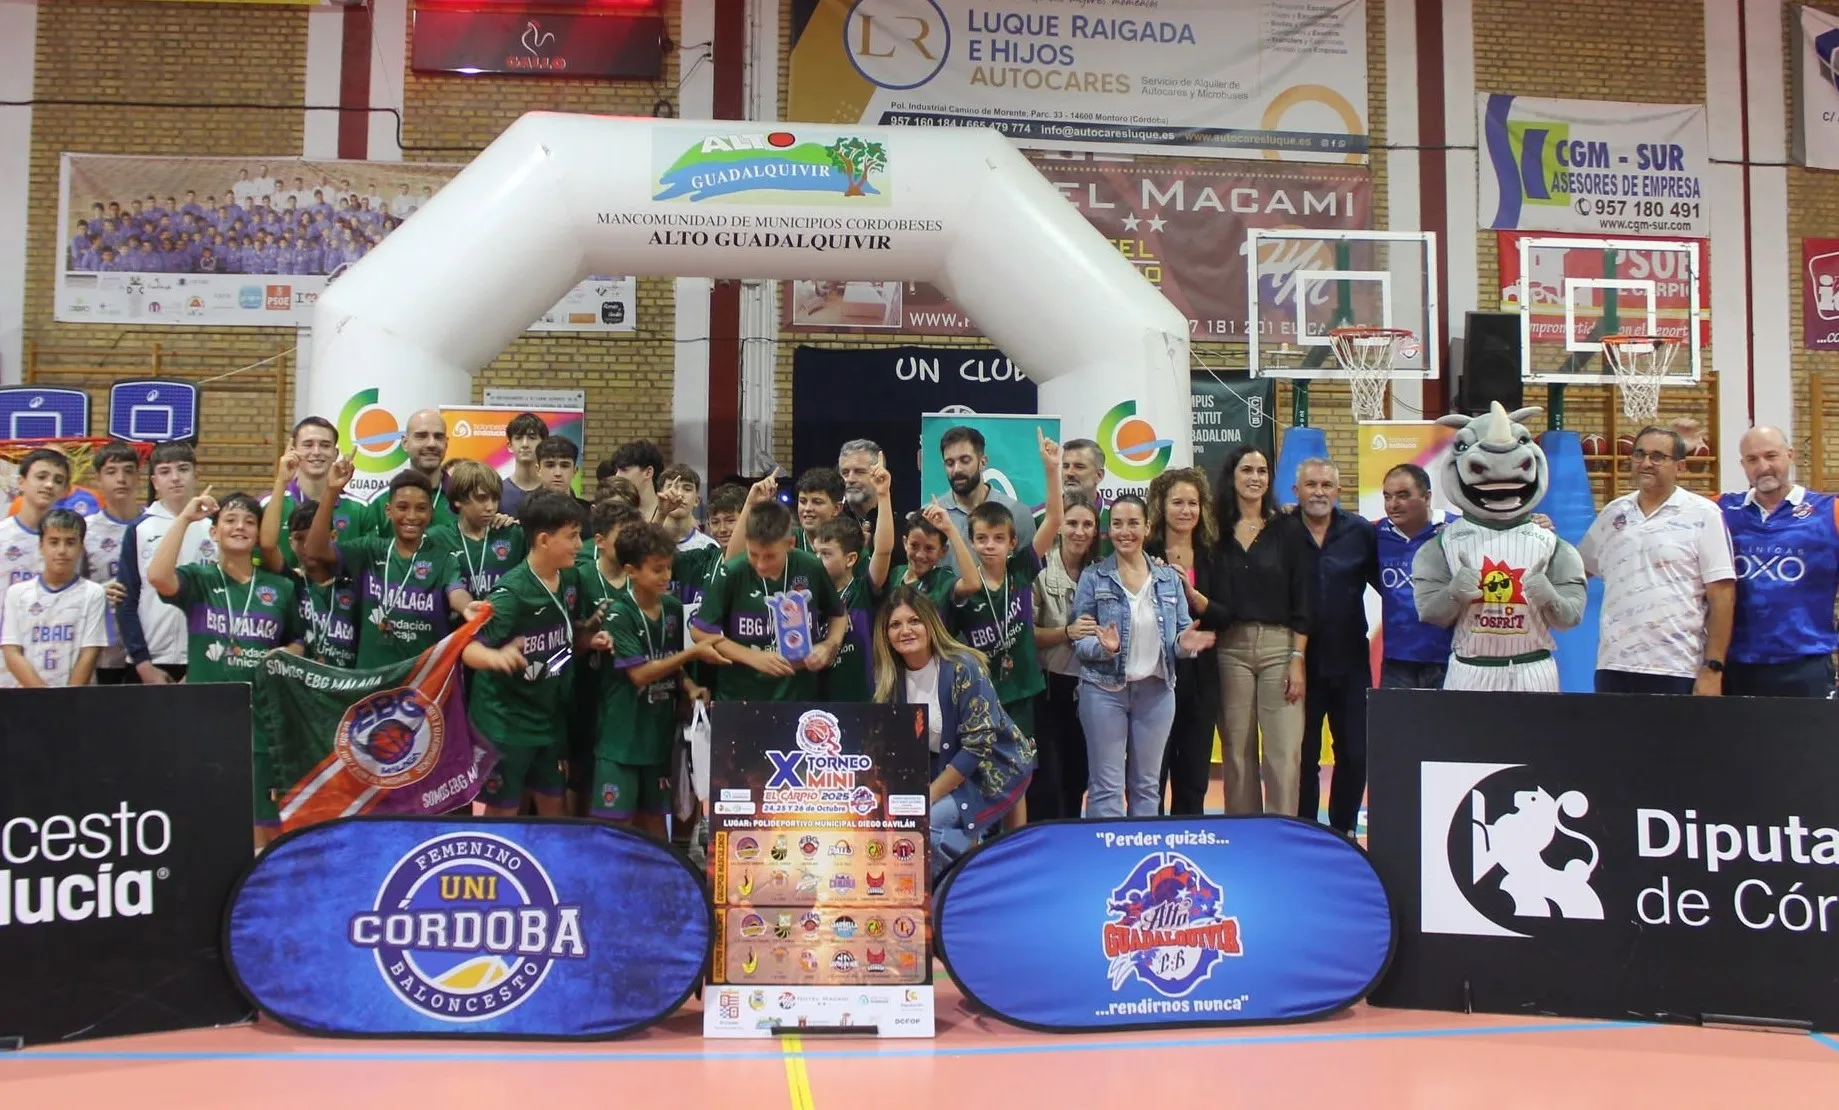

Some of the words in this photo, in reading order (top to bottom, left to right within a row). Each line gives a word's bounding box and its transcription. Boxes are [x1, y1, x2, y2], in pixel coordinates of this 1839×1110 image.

[968, 9, 1059, 37] LUQUE
[1072, 14, 1196, 45] RAIGADA
[969, 40, 982, 61] E
[991, 40, 1075, 66] HIJOS
[970, 66, 1131, 94] AUTOCARES
[1141, 76, 1178, 87] Servicio
[1181, 78, 1191, 87] de
[1194, 79, 1227, 90] Alquiler
[1229, 81, 1240, 89] de
[1141, 86, 1188, 97] Autocares
[1189, 90, 1195, 98] y
[1197, 89, 1249, 100] Microbuses
[891, 101, 906, 110] Pol.
[909, 102, 947, 112] Industrial
[949, 105, 980, 114] Camino
[981, 106, 992, 115] de
[994, 108, 1029, 118] Morente,
[1031, 109, 1050, 118] Parc.
[1053, 110, 1063, 118] 33
[1070, 112, 1093, 121] 14600
[1096, 112, 1128, 122] Montoro
[1130, 114, 1169, 125] (Córdoba)
[890, 116, 909, 126] 957
[914, 117, 934, 127] 160
[1012, 123, 1031, 133] 774
[1041, 124, 1175, 142] info@autocaresluque.es
[1184, 130, 1311, 147] www.autocaresluque.es
[1556, 140, 1610, 168] CGM
[1637, 144, 1685, 171] SUR
[691, 164, 831, 190] GUADALQUIVIR
[1551, 171, 1618, 196] ASESORES
[1623, 175, 1638, 197] DE
[1643, 175, 1700, 199] EMPRESA
[1142, 178, 1354, 217] MACAMI
[1595, 200, 1626, 217] 957
[1633, 201, 1664, 218] 180
[1670, 202, 1700, 219] 491
[597, 212, 727, 228] MANCOMUNIDAD
[731, 216, 751, 228] DE
[755, 217, 842, 231] MUNICIPIOS
[846, 218, 943, 232] CORDOBESES
[1600, 218, 1692, 233] www.cgm-sur.com
[648, 230, 709, 247] ALTO
[714, 232, 892, 251] GUADALQUIVIR
[1207, 320, 1235, 334] 181
[895, 356, 940, 383] UN
[1192, 411, 1222, 425] ENTUT
[1381, 567, 1415, 589] OX
[31, 624, 76, 643] CBAG
[738, 616, 764, 637] EBG
[970, 625, 997, 648] EBG
[44, 649, 57, 671] 6
[304, 672, 331, 690] EBG
[768, 752, 805, 788] X
[807, 756, 872, 773] TORNEO
[808, 772, 855, 789] MINI
[449, 772, 470, 797] EBG
[764, 791, 778, 801] EL
[780, 789, 819, 803] CARPIO
[820, 791, 850, 801] 2025
[788, 804, 794, 812] Y
[795, 804, 804, 812] 26
[806, 804, 815, 812] de
[817, 803, 847, 812] Octubre
[723, 819, 752, 828] LUGAR:
[753, 819, 814, 829] POLIDEPORTIVO
[814, 819, 857, 829] MUNICIPAL
[858, 820, 881, 829] DIEGO
[882, 817, 916, 829] GAVILÁN
[1096, 831, 1162, 848] "Perder
[1165, 829, 1230, 849] quizás...
[414, 840, 522, 871] FEMENINO
[439, 875, 498, 900] UNI
[1636, 875, 1711, 927] de
[352, 898, 585, 956] CÓRDOBA
[1104, 918, 1241, 958] GUADALQUIVIR
[389, 960, 538, 1013] BALONCESTO
[1095, 997, 1190, 1016] ...rendirnos
[1193, 994, 1249, 1012] nunca"
